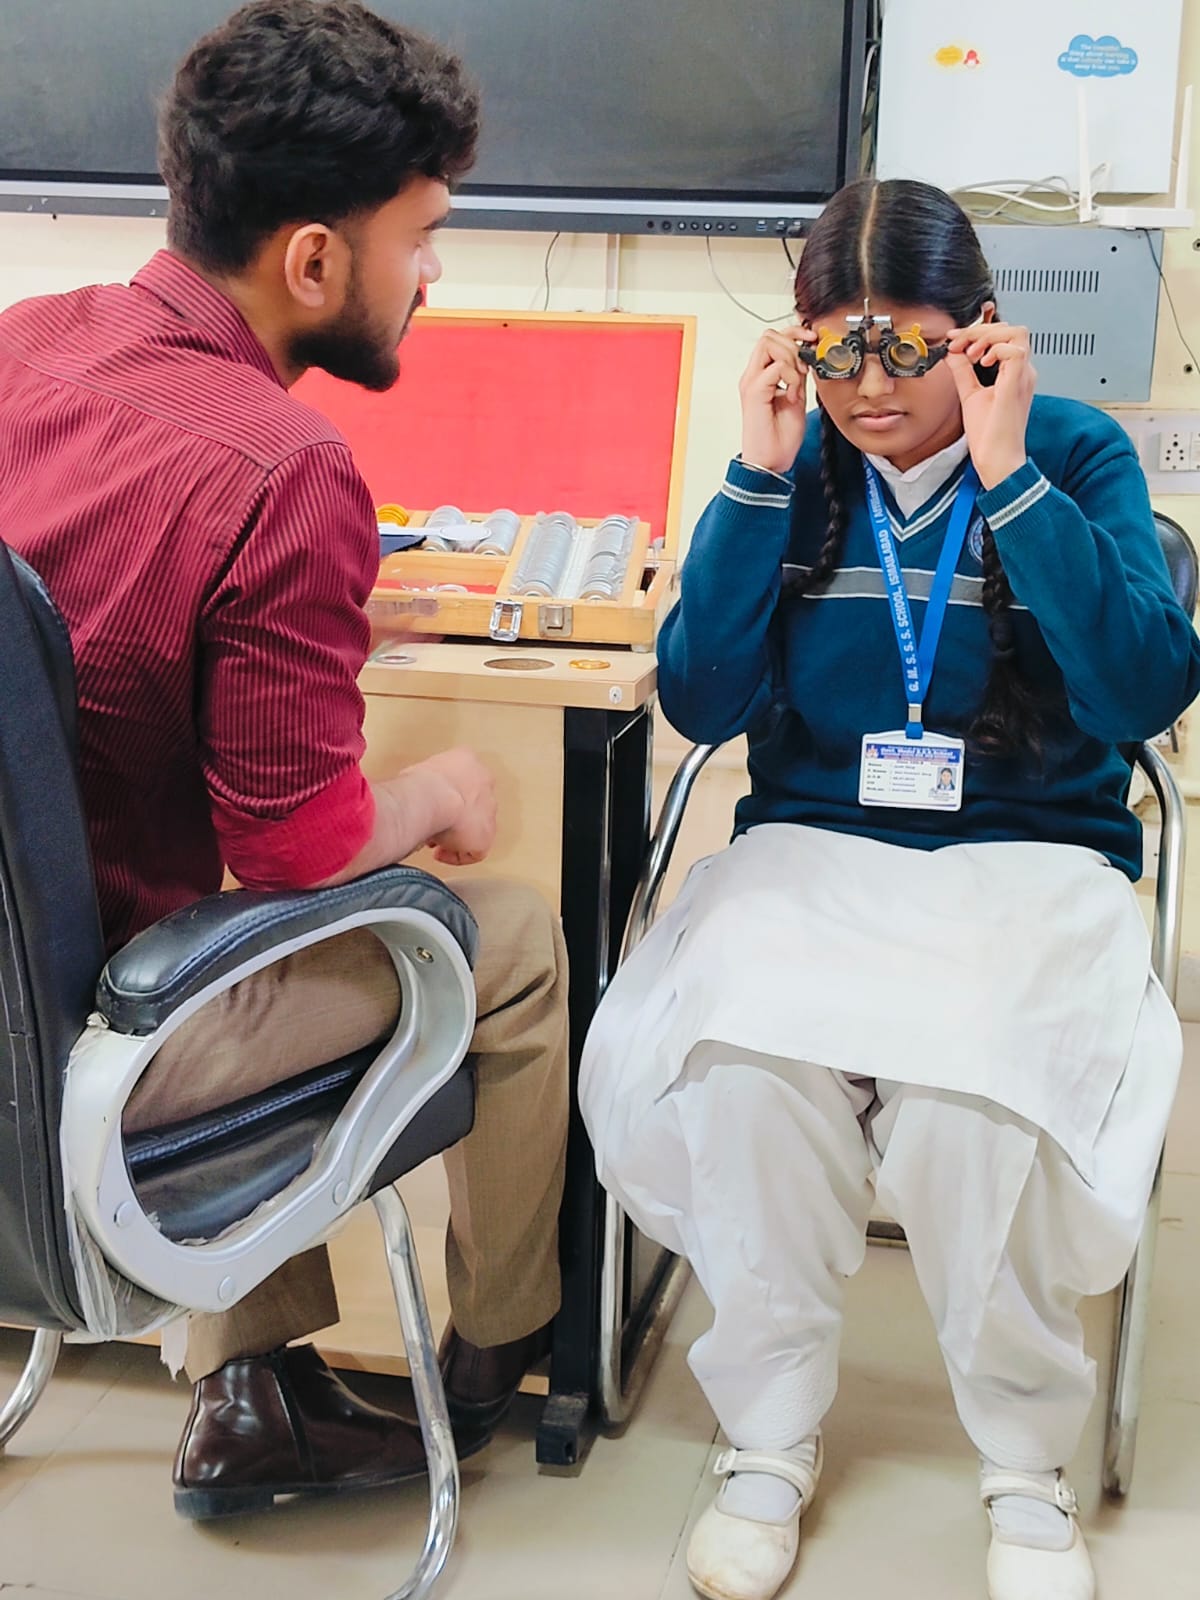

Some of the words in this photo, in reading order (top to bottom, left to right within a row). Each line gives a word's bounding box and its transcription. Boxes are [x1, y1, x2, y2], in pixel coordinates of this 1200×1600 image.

[900, 628, 911, 640] S.
[903, 640, 914, 652] S.
[905, 653, 917, 665] S.
[906, 666, 919, 680] M.
[908, 681, 920, 692] G.
